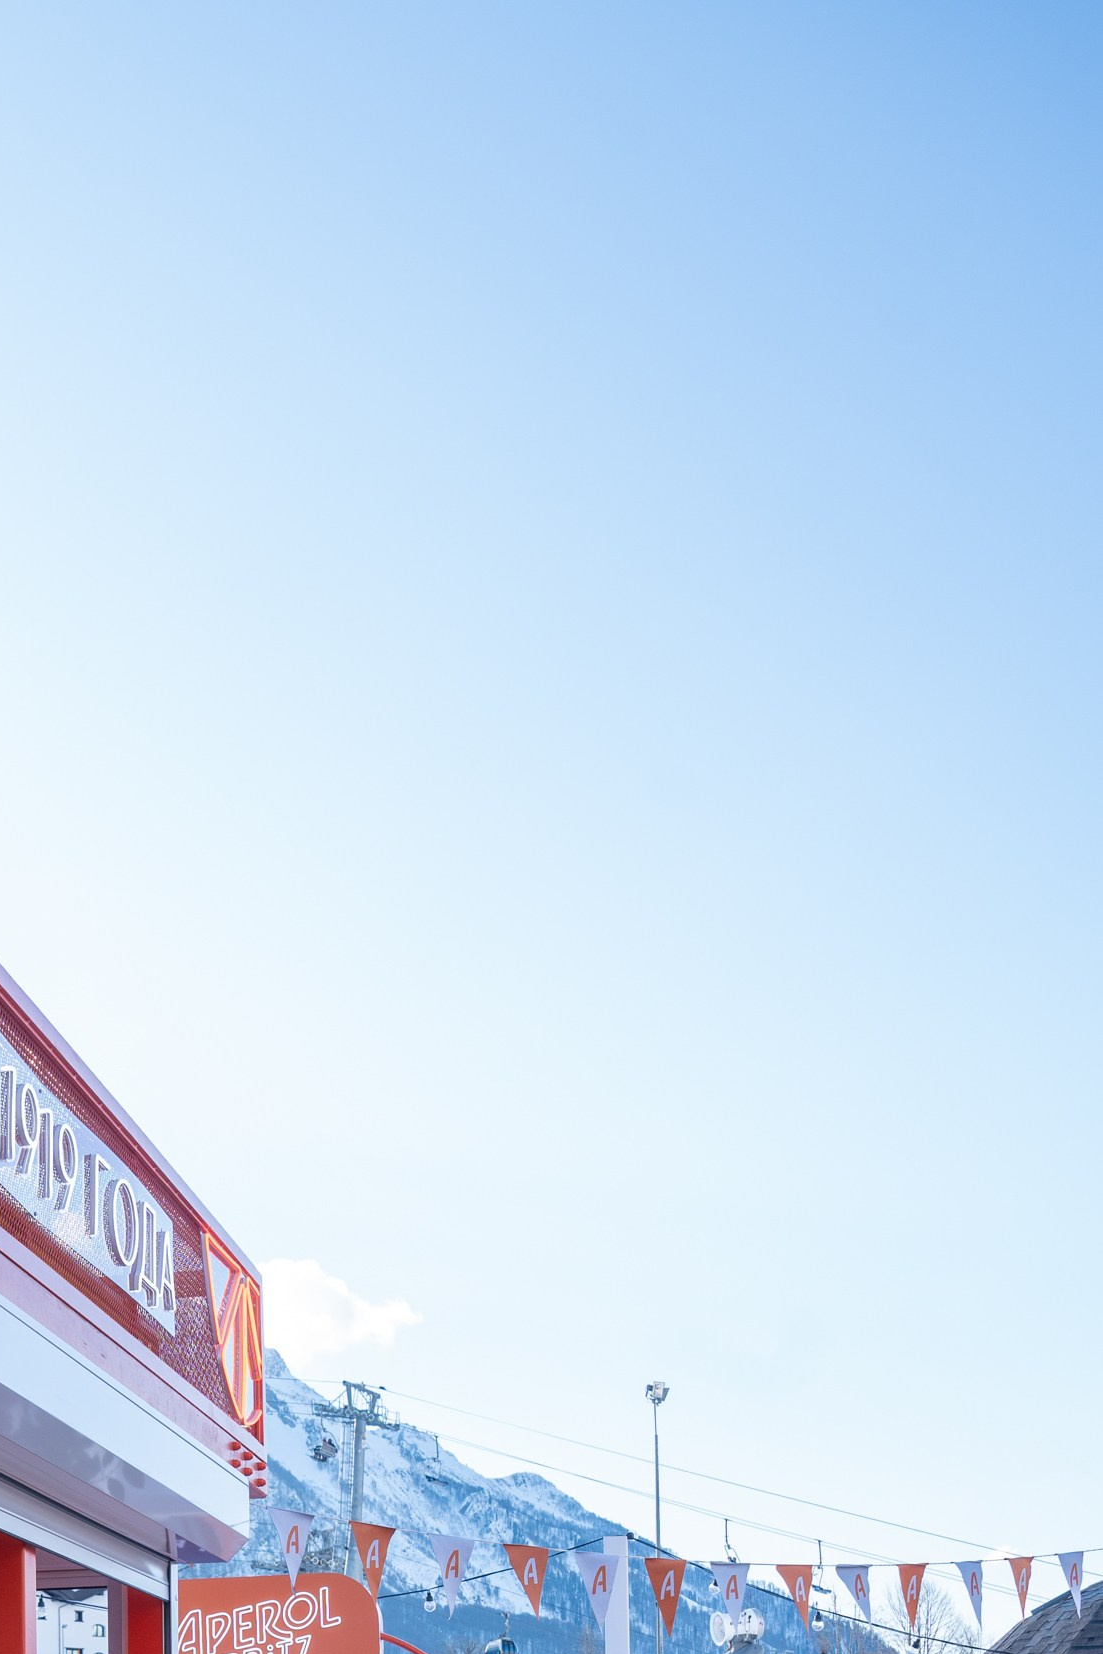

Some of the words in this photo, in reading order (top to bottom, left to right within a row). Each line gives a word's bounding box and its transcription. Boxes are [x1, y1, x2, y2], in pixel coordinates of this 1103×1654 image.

[0, 1065, 79, 1213] 1919
[84, 1153, 177, 1311] ГОДА
[285, 1525, 299, 1554] A
[366, 1539, 380, 1569] A
[445, 1549, 459, 1579] A
[523, 1557, 539, 1586] A
[1070, 1562, 1079, 1588] A
[592, 1565, 607, 1595] A
[660, 1569, 675, 1600] A
[726, 1574, 740, 1600] A
[795, 1575, 807, 1602] A
[854, 1572, 867, 1600] A
[907, 1574, 917, 1603] A
[970, 1571, 980, 1597] A
[1018, 1567, 1027, 1594] A
